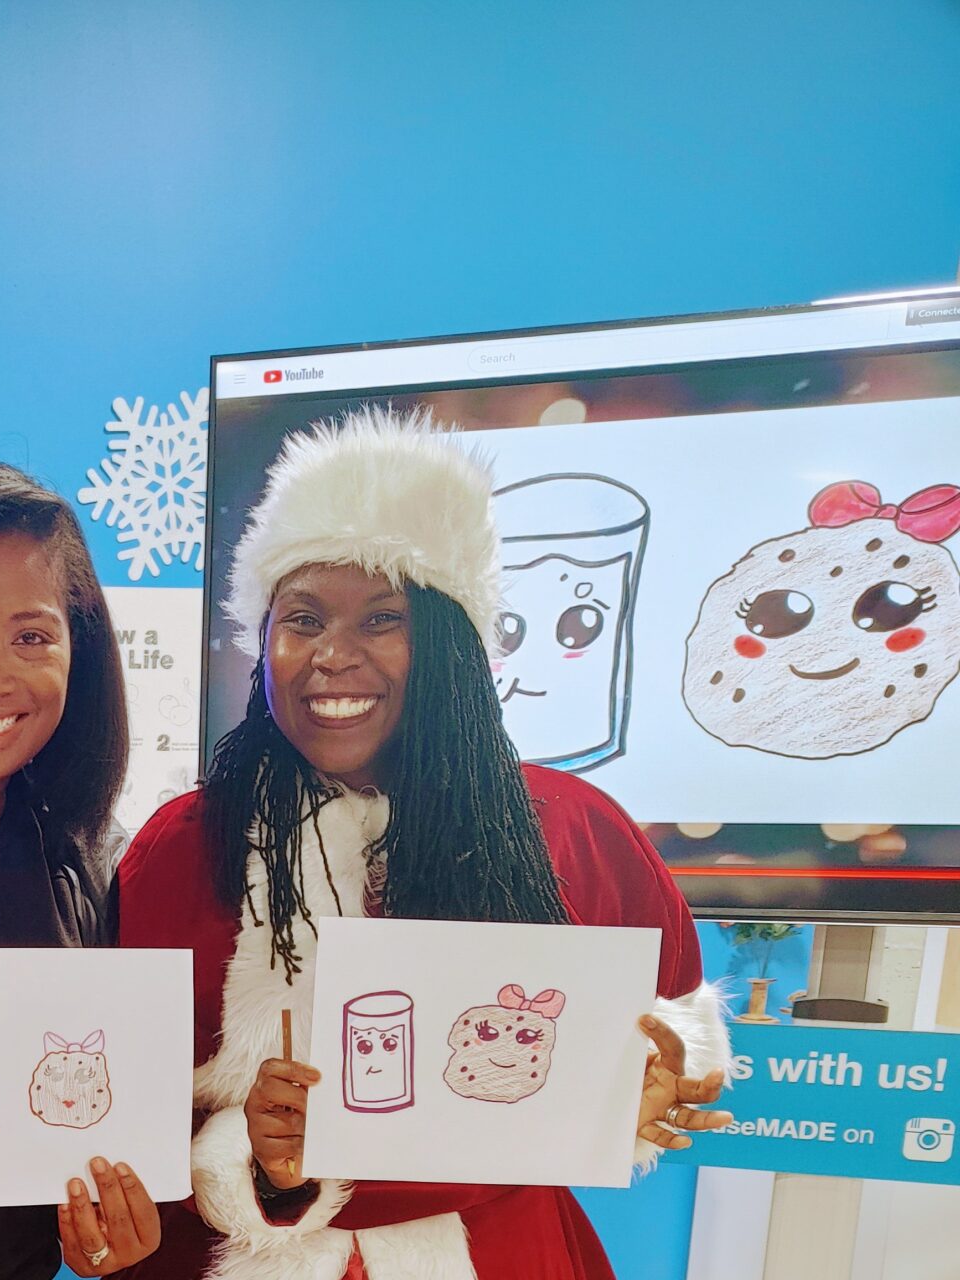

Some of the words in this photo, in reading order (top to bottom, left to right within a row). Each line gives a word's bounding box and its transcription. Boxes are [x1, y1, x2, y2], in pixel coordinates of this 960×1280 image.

[480, 352, 516, 364] Search
[285, 367, 324, 382] YouTube
[115, 630, 137, 645] w
[144, 629, 159, 646] a
[128, 649, 175, 670] Life
[156, 734, 171, 752] 2
[730, 1054, 755, 1081] s
[767, 1051, 863, 1087] with
[878, 1058, 948, 1092] us!
[711, 1117, 837, 1142] seMADE
[843, 1127, 875, 1145] on
